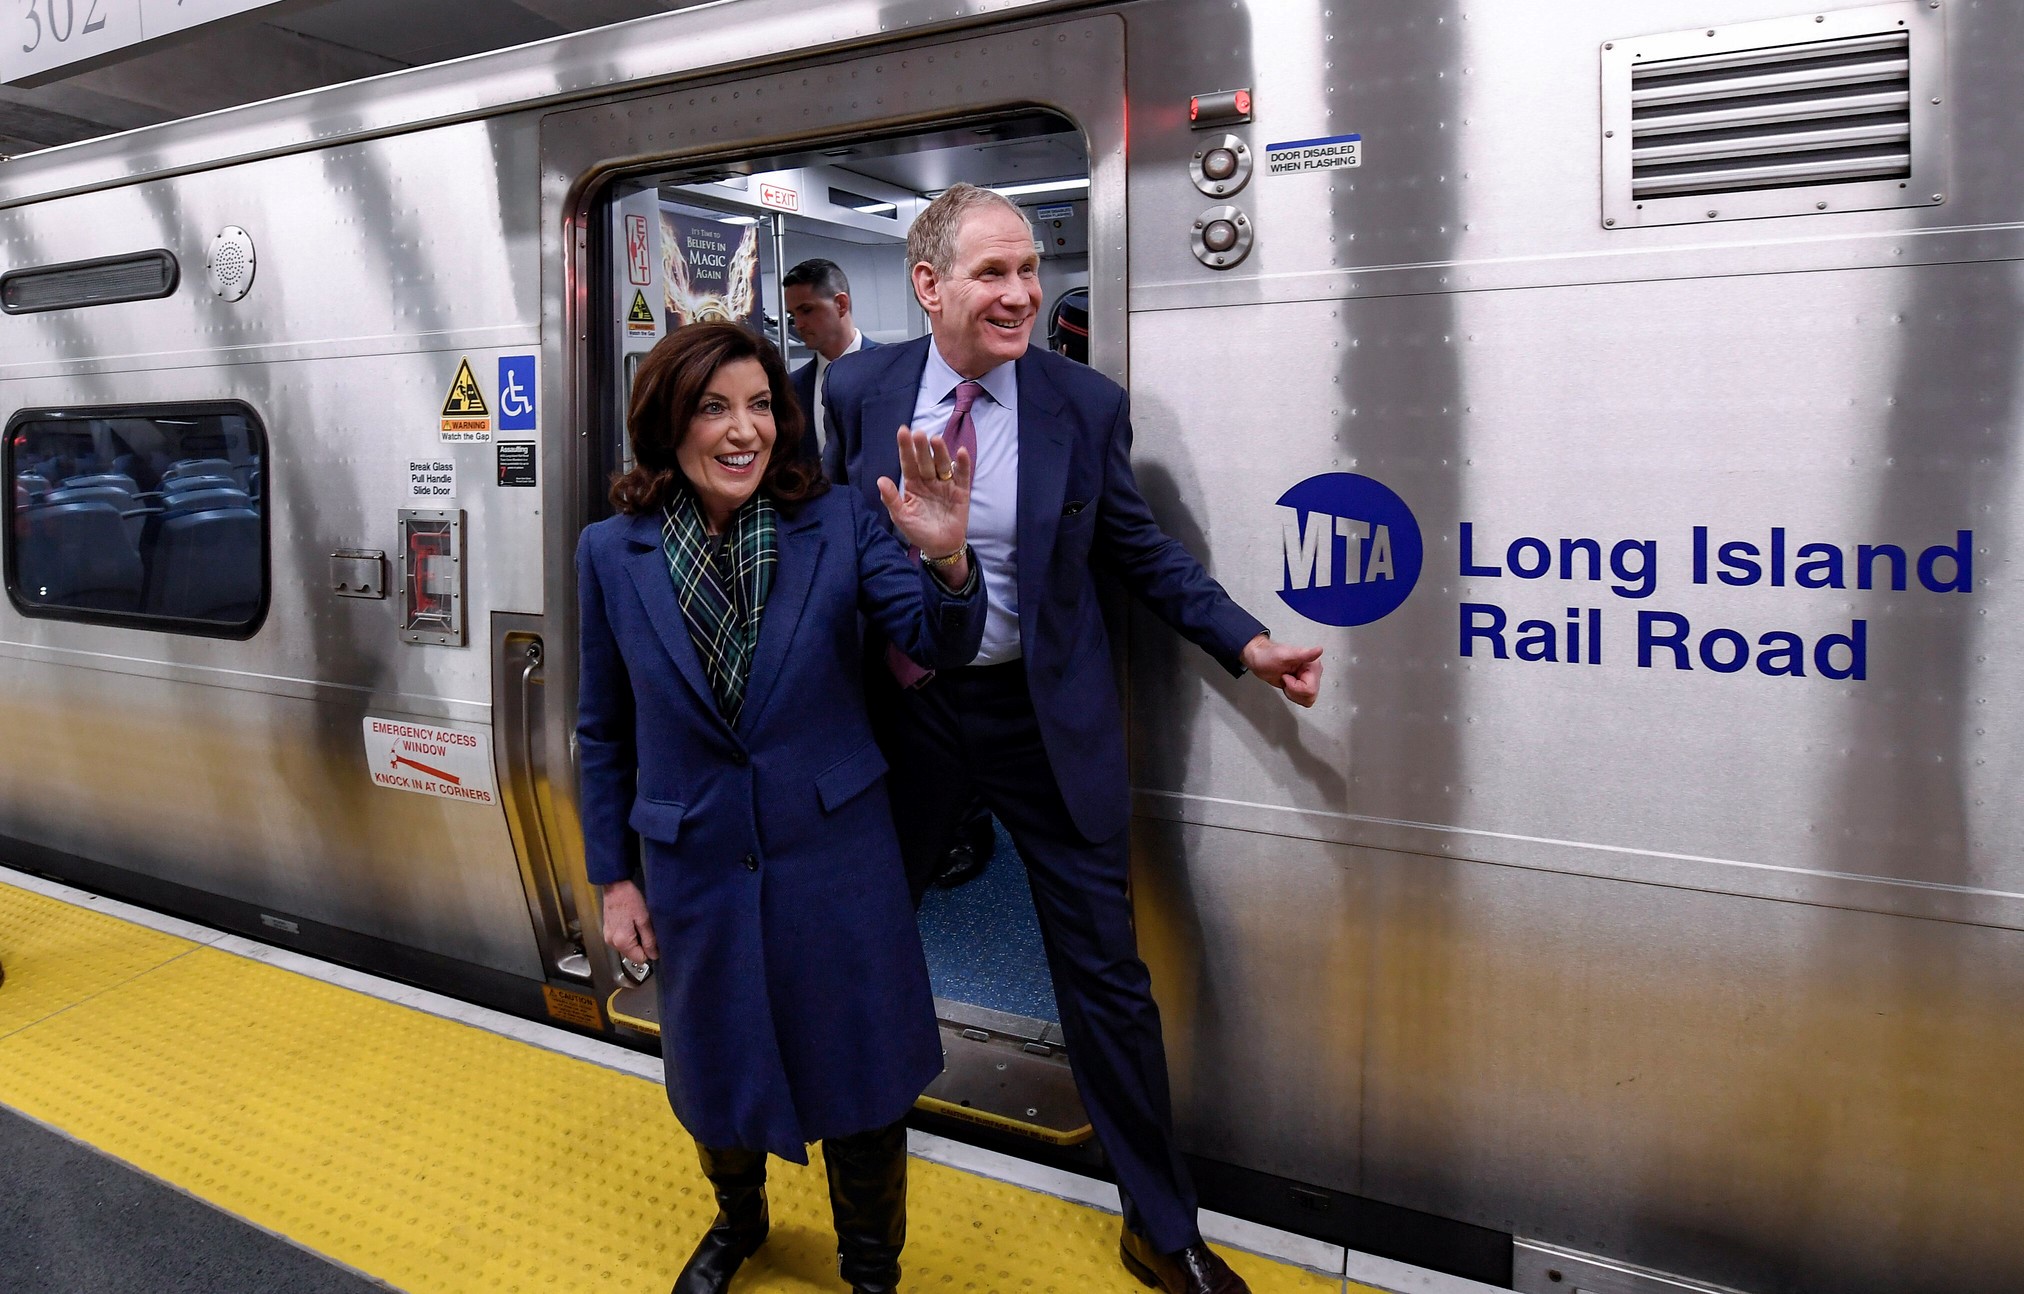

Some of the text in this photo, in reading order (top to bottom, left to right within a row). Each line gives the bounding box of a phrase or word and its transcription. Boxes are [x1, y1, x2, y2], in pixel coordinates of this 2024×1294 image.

[1271, 145, 1355, 162] DOOR DISABLED
[1271, 156, 1356, 173] WHEN FLASHING
[775, 191, 795, 207] EXIT
[636, 219, 647, 282] EXIT
[687, 236, 726, 252] BELIEVE IN
[689, 249, 726, 267] MAGIC
[696, 267, 722, 280] AGAIN
[453, 421, 485, 429] WARNING
[442, 432, 490, 441] Watch the Gap
[410, 462, 453, 471] Break Glass
[411, 474, 452, 483] Pull Handle
[413, 486, 450, 494] Slide Door
[1275, 504, 1395, 590] MTA
[1458, 522, 1974, 599] Long Island
[1458, 602, 1868, 682] Rail Road
[372, 722, 477, 747] EMERGENCY ACCESS
[403, 740, 446, 756] WINDOW
[374, 772, 491, 802] KNOCK IN AT CORNERS
[558, 991, 593, 1006] CAUTION
